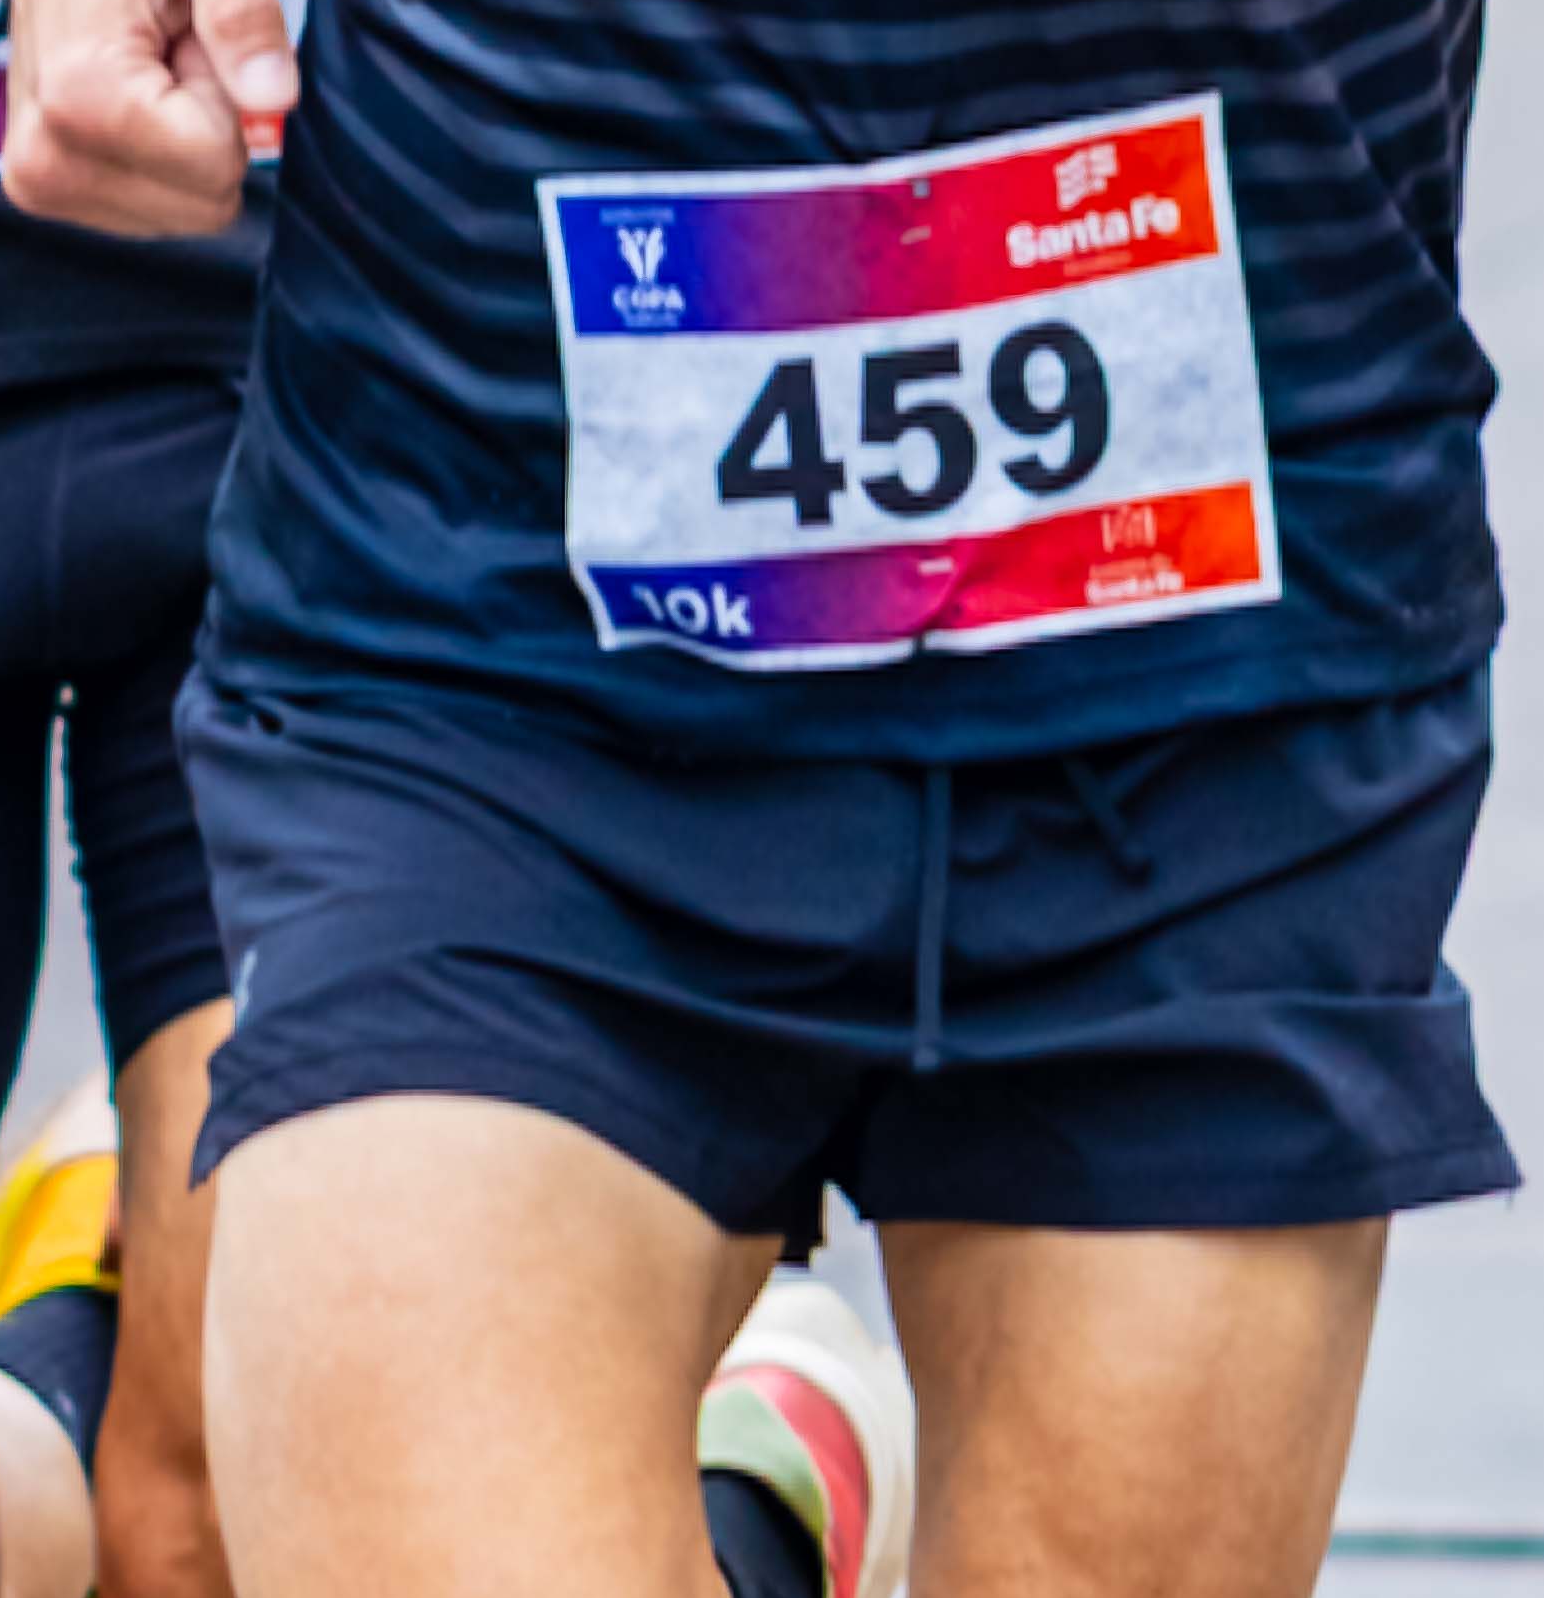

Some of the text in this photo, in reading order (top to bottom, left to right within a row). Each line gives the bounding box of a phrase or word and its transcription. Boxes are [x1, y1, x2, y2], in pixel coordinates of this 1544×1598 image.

[1006, 210, 1130, 268] Santa
[1130, 193, 1181, 240] Fe
[717, 323, 1110, 527] 459
[631, 581, 752, 638] 10k
